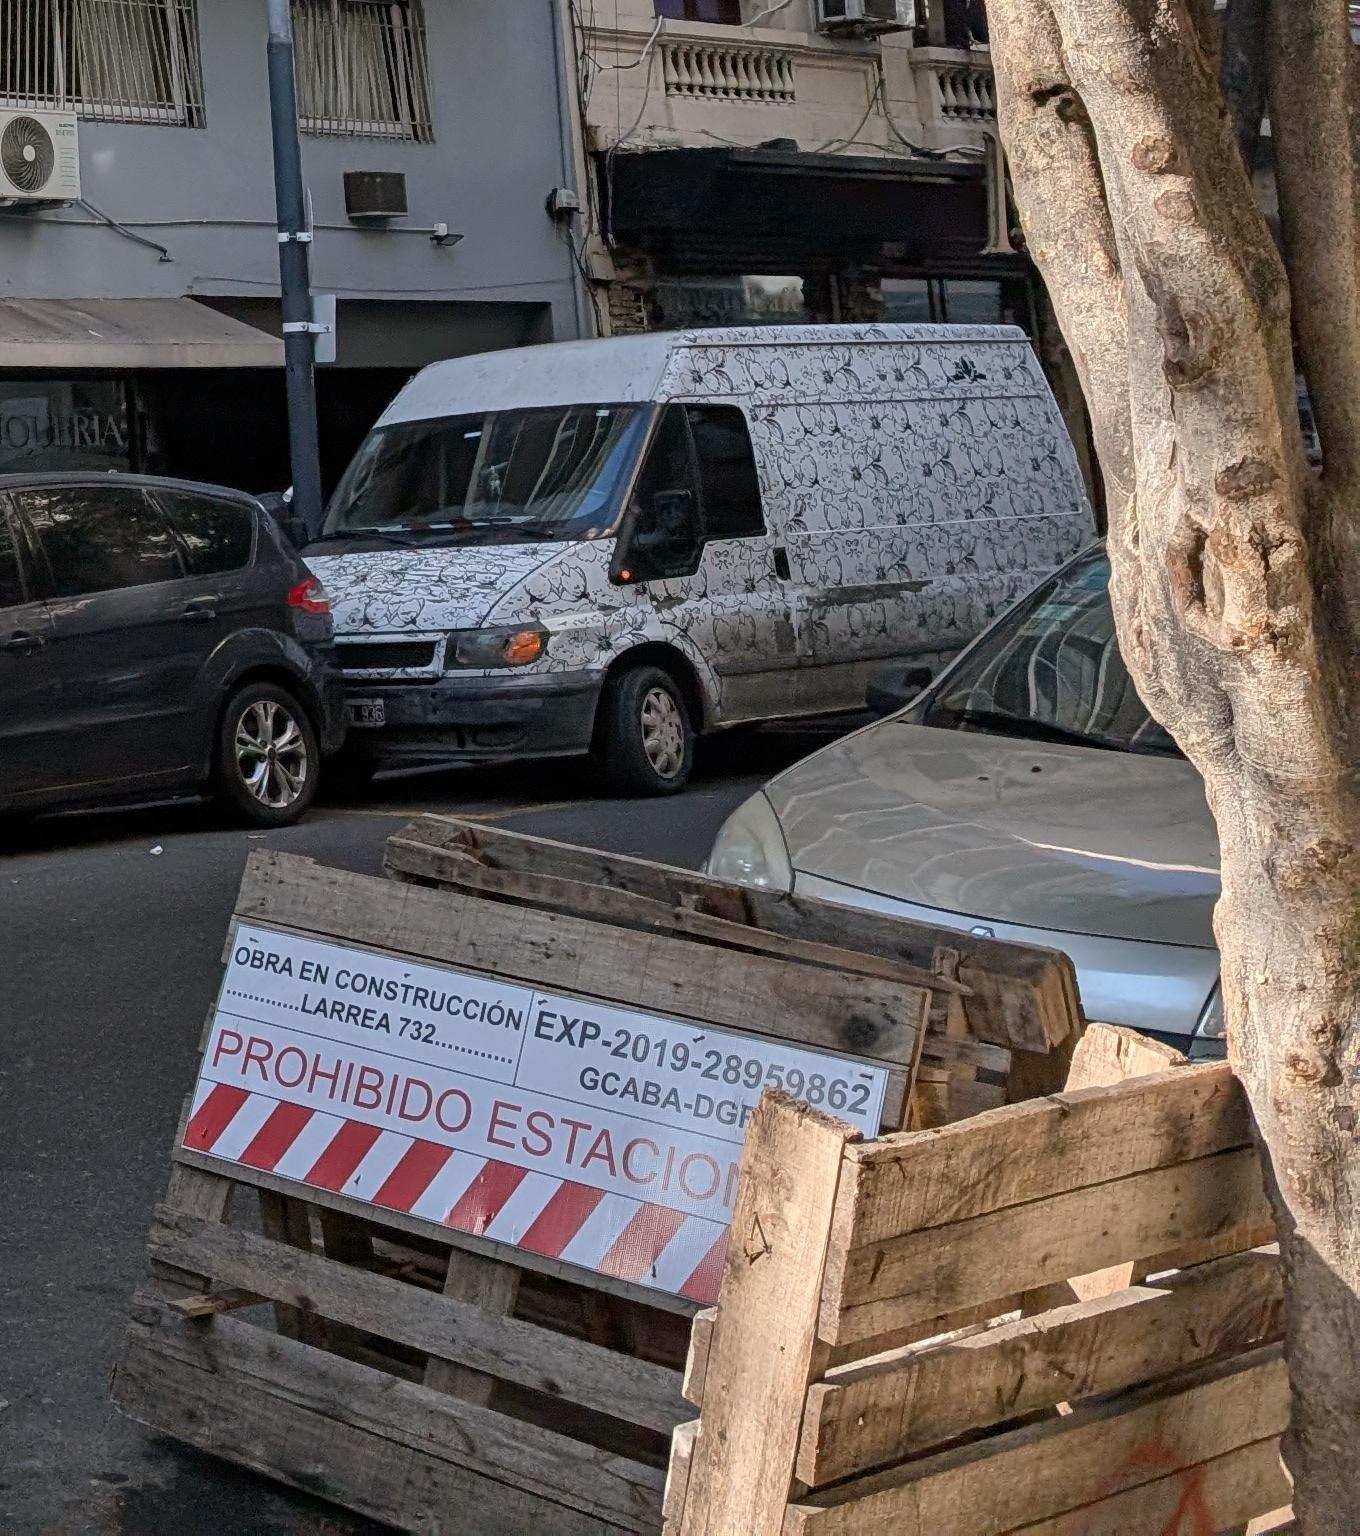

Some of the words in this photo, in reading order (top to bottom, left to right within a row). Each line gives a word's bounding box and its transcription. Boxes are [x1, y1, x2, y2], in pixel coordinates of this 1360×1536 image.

[235, 946, 293, 978] OBRA
[299, 960, 330, 985] EN
[335, 969, 523, 1031] CONSTRUCCIÓN
[212, 1028, 472, 1133] PROHIBIDO
[533, 1010, 872, 1116] EXP-2019-28959862
